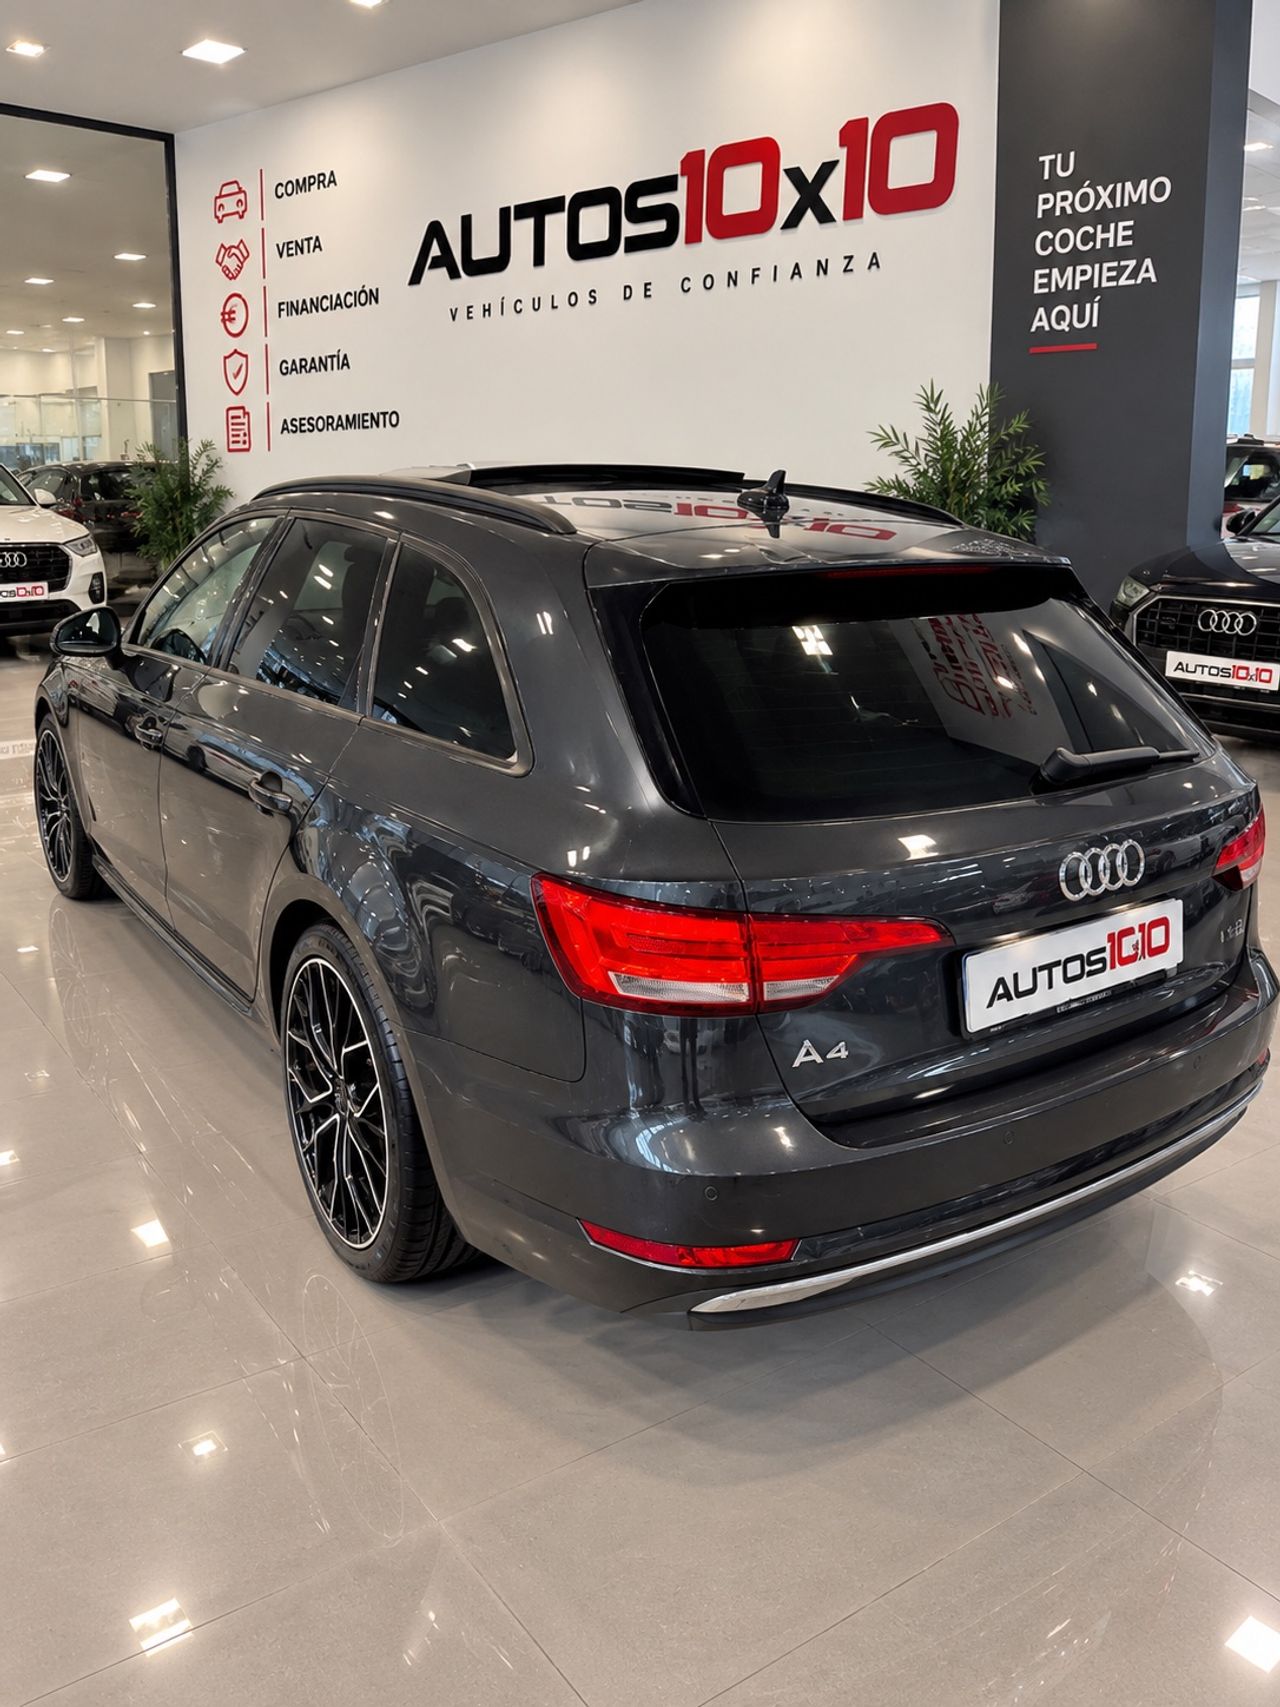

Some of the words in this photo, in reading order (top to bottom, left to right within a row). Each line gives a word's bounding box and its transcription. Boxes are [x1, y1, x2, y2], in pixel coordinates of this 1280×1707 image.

[1038, 151, 1075, 181] TU
[274, 170, 338, 200] COMPRA
[407, 101, 960, 287] AUTOS10x10
[1036, 176, 1172, 219] PRÓXIMO
[275, 235, 323, 259] VENTA
[1034, 220, 1135, 257] COCHE
[449, 288, 598, 322] VEHÍCULOS
[622, 281, 653, 301] DE
[679, 251, 882, 293] CONFIANZA
[1033, 257, 1158, 294] EMPIEZA
[277, 284, 380, 319] FINANCIACIÓN
[1030, 295, 1102, 333] AQUÍ
[279, 348, 351, 377] GARANTÍA
[280, 410, 401, 435] ASESORAMIENTO
[791, 1039, 849, 1068] A4
